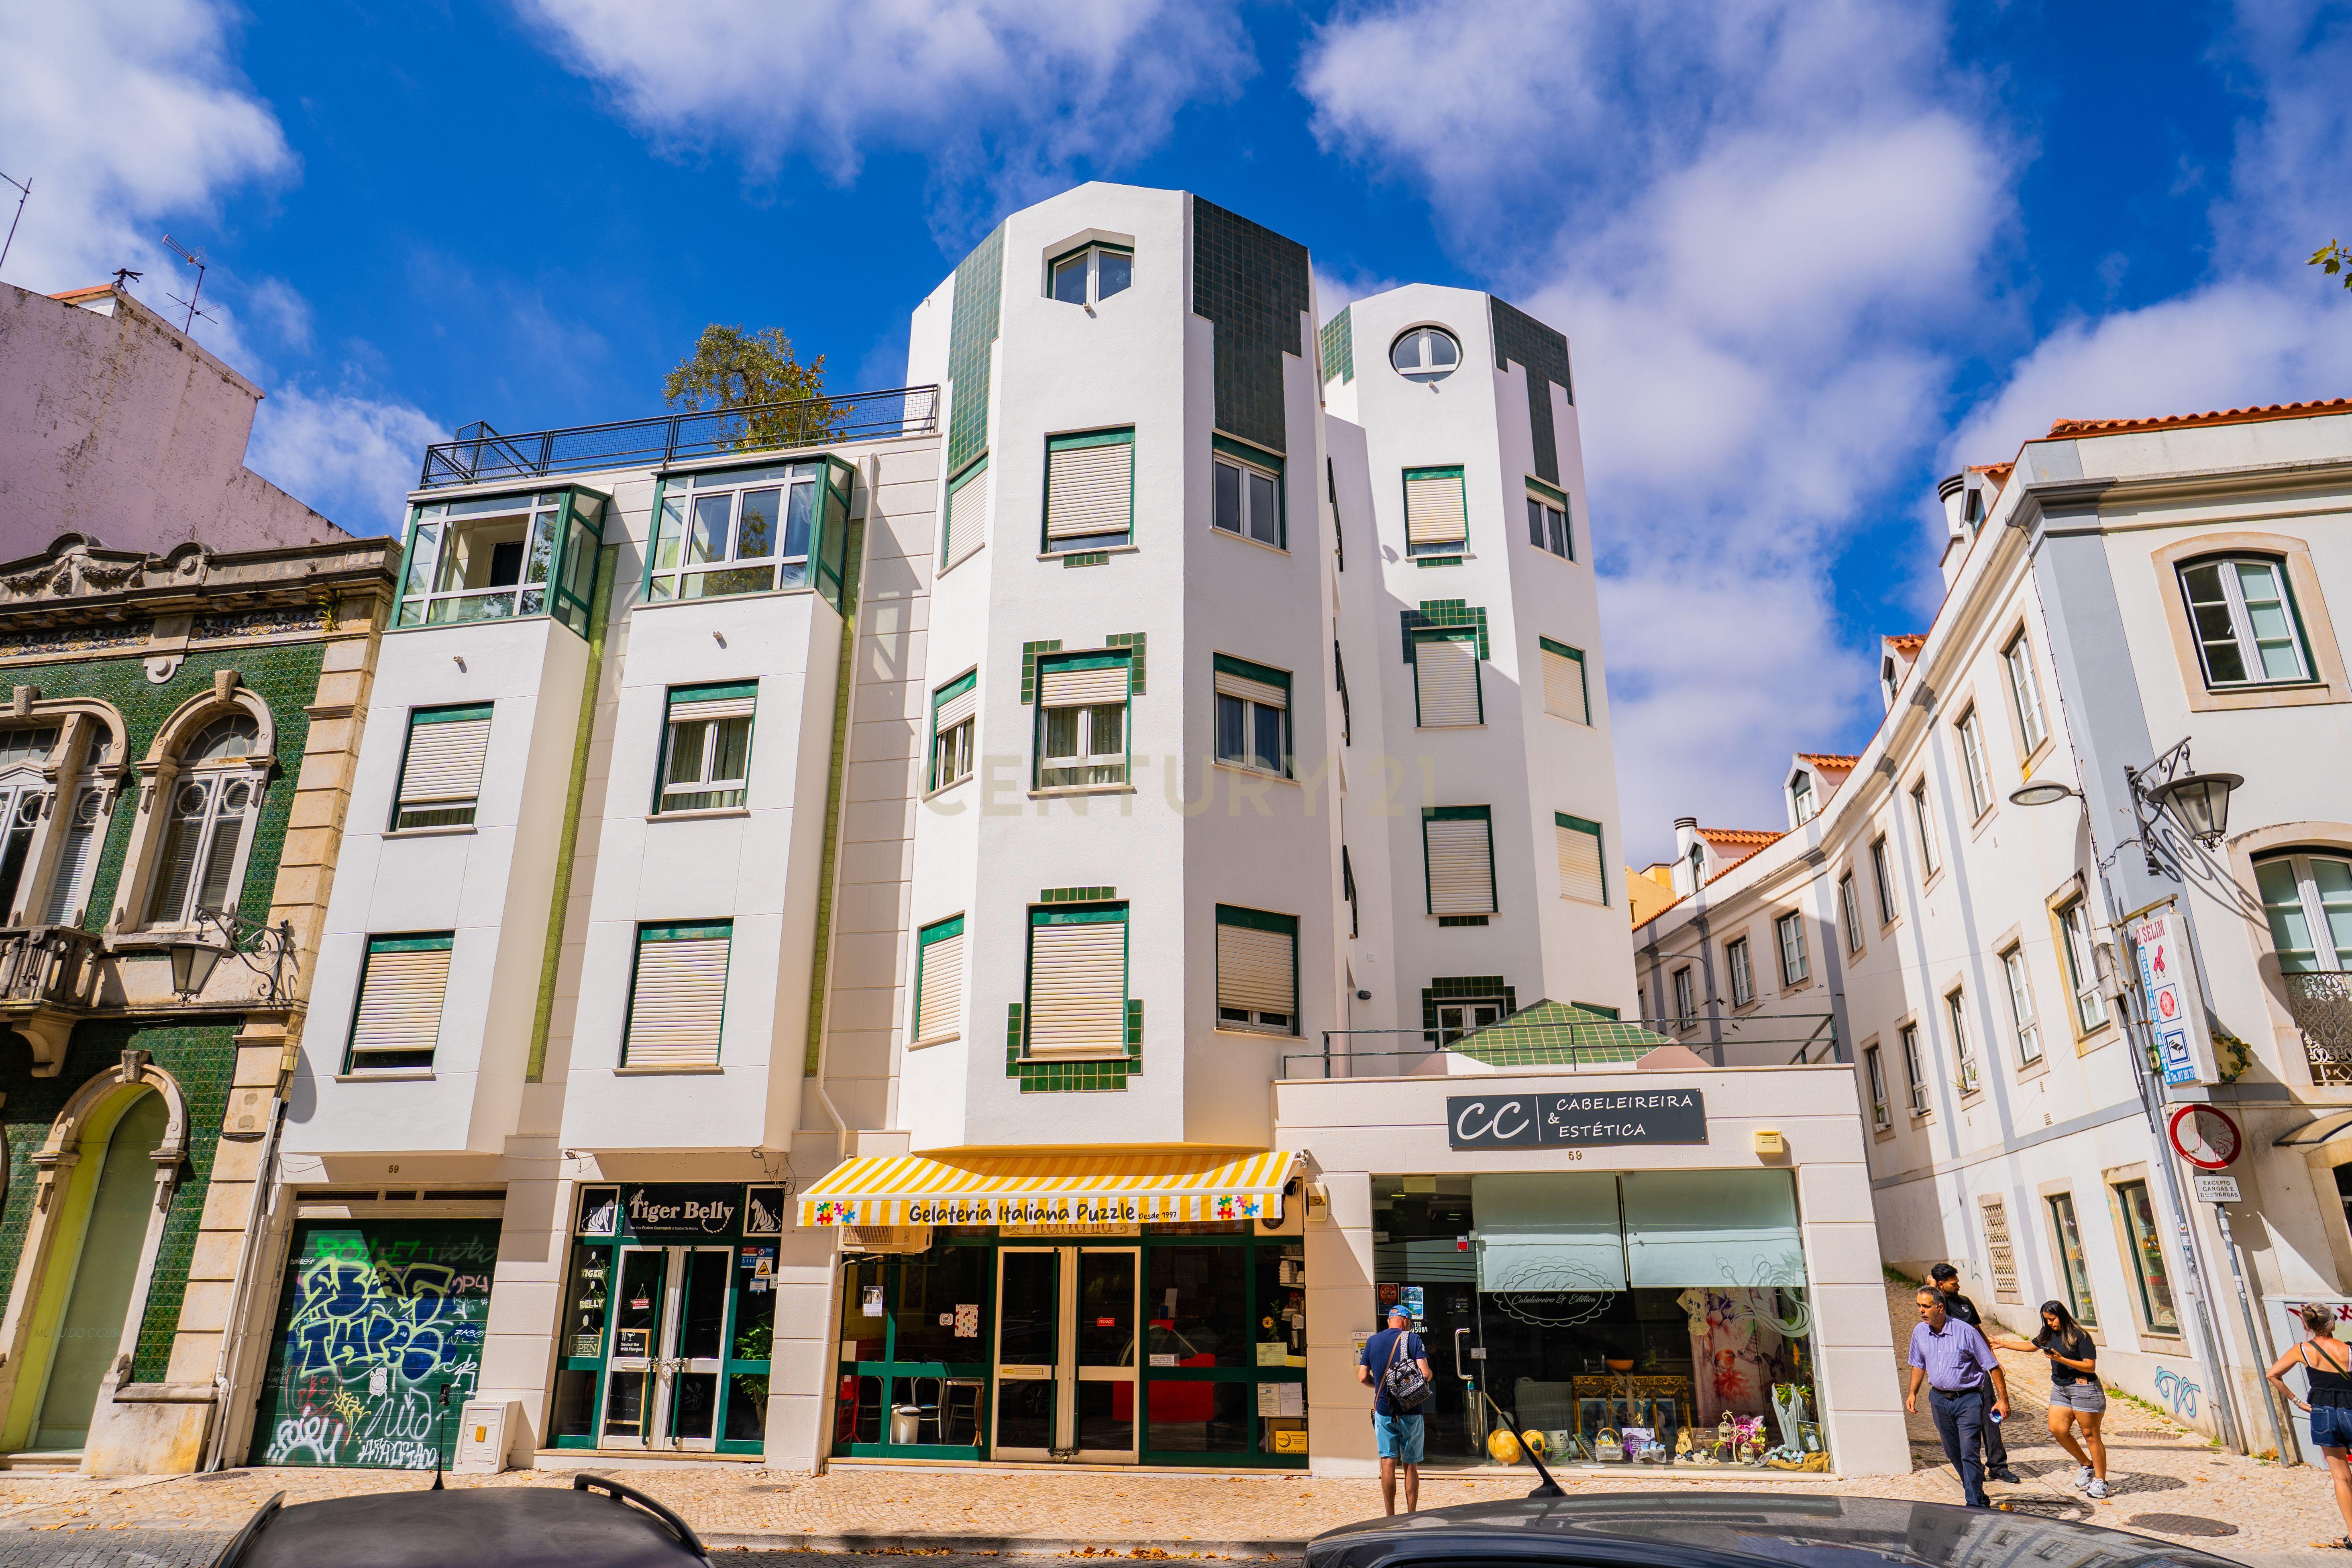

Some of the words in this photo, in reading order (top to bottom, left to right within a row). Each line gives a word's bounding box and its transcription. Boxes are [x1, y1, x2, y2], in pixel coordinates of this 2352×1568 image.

[2136, 929, 2141, 945] O
[2142, 919, 2165, 942] SELIM
[2139, 948, 2171, 1083] RESTAURANTE
[1556, 1095, 1693, 1111] CABELEIREIRA
[1548, 1112, 1560, 1124] &
[1559, 1121, 1646, 1138] ESTÉTICA
[1568, 1151, 1582, 1161] 59
[388, 1165, 399, 1173] 59
[630, 1201, 681, 1223] Tiger
[683, 1201, 735, 1233] Belly
[909, 1204, 992, 1223] Gelateria
[999, 1203, 1070, 1222] Italiana
[1077, 1203, 1135, 1222] Puzzle
[581, 1269, 603, 1278] TIGER
[579, 1299, 604, 1309] BELLY
[1512, 1294, 1555, 1305] Cabeleireiro
[1568, 1294, 1597, 1305] Estética
[69, 1328, 85, 1338] DO
[572, 1344, 598, 1353] OPEN
